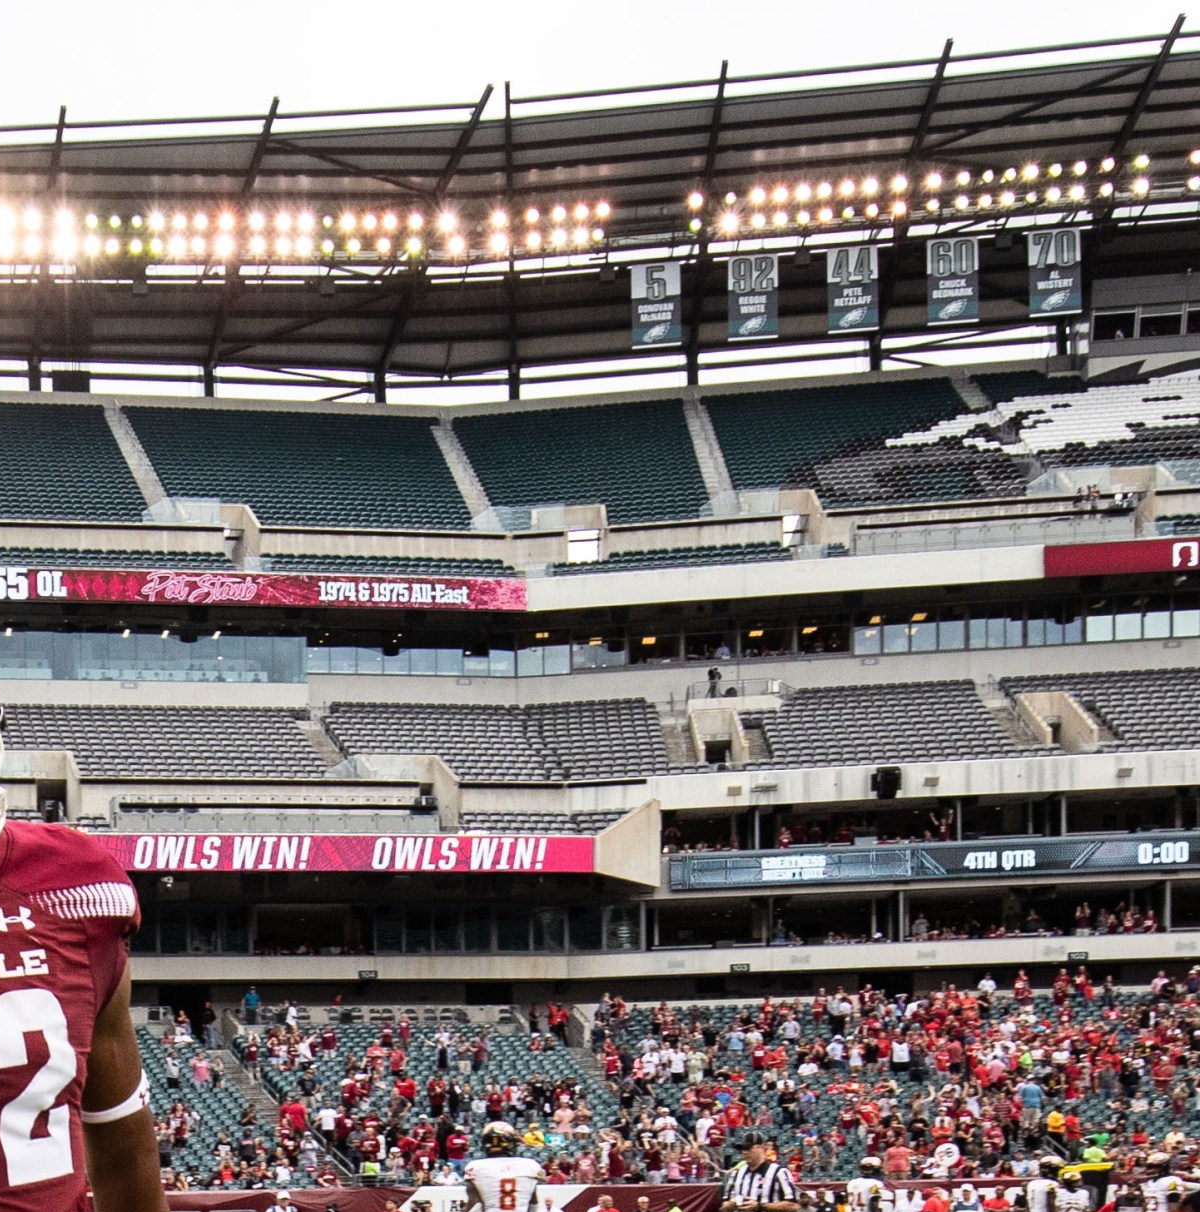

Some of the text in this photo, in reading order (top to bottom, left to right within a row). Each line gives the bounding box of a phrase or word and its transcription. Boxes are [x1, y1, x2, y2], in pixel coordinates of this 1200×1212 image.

[930, 238, 976, 277] 60
[1032, 229, 1077, 269] 70
[645, 265, 667, 300] 5
[731, 256, 774, 294] 92
[832, 247, 873, 286] 44
[843, 287, 863, 297] PETE
[938, 278, 967, 289] CHUCK
[740, 304, 766, 314] WHITE
[834, 295, 873, 307] RETZLAFF
[36, 571, 68, 598] OL
[141, 569, 190, 602] Pat
[318, 580, 470, 604] 1974 & 1975 All-East
[133, 836, 312, 870] OWLS WIN!
[371, 837, 549, 870] OWLS WIN!
[963, 841, 1190, 870] 4TH QTR 0:00
[499, 1178, 516, 1211] 8
